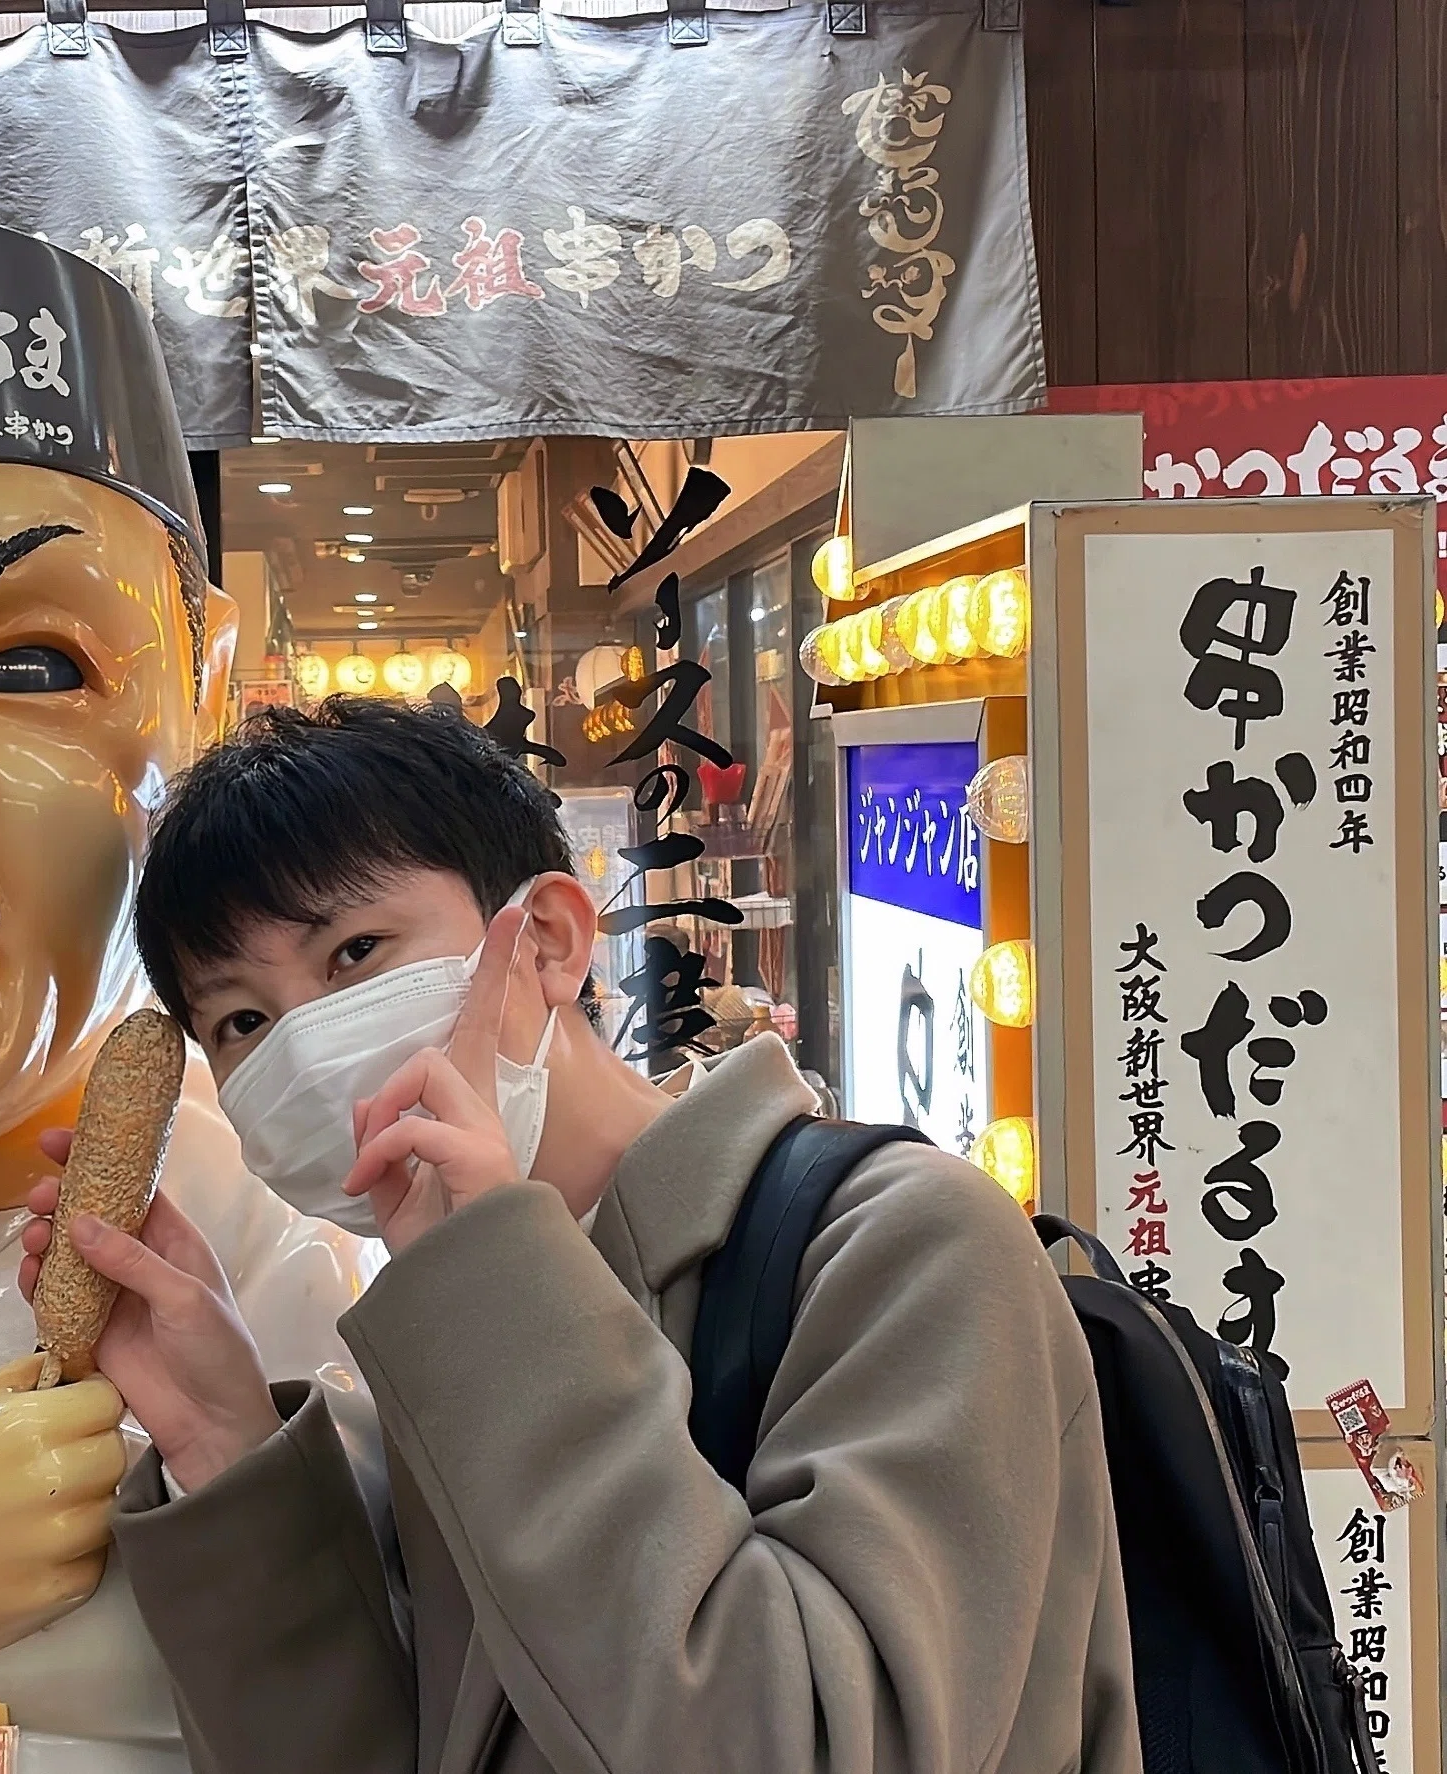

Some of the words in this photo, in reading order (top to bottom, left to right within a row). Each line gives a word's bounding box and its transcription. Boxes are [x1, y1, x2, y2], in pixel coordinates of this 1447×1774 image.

[1179, 566, 1328, 1384] 串かつだるま
[1319, 569, 1377, 855] 創業昭和四年
